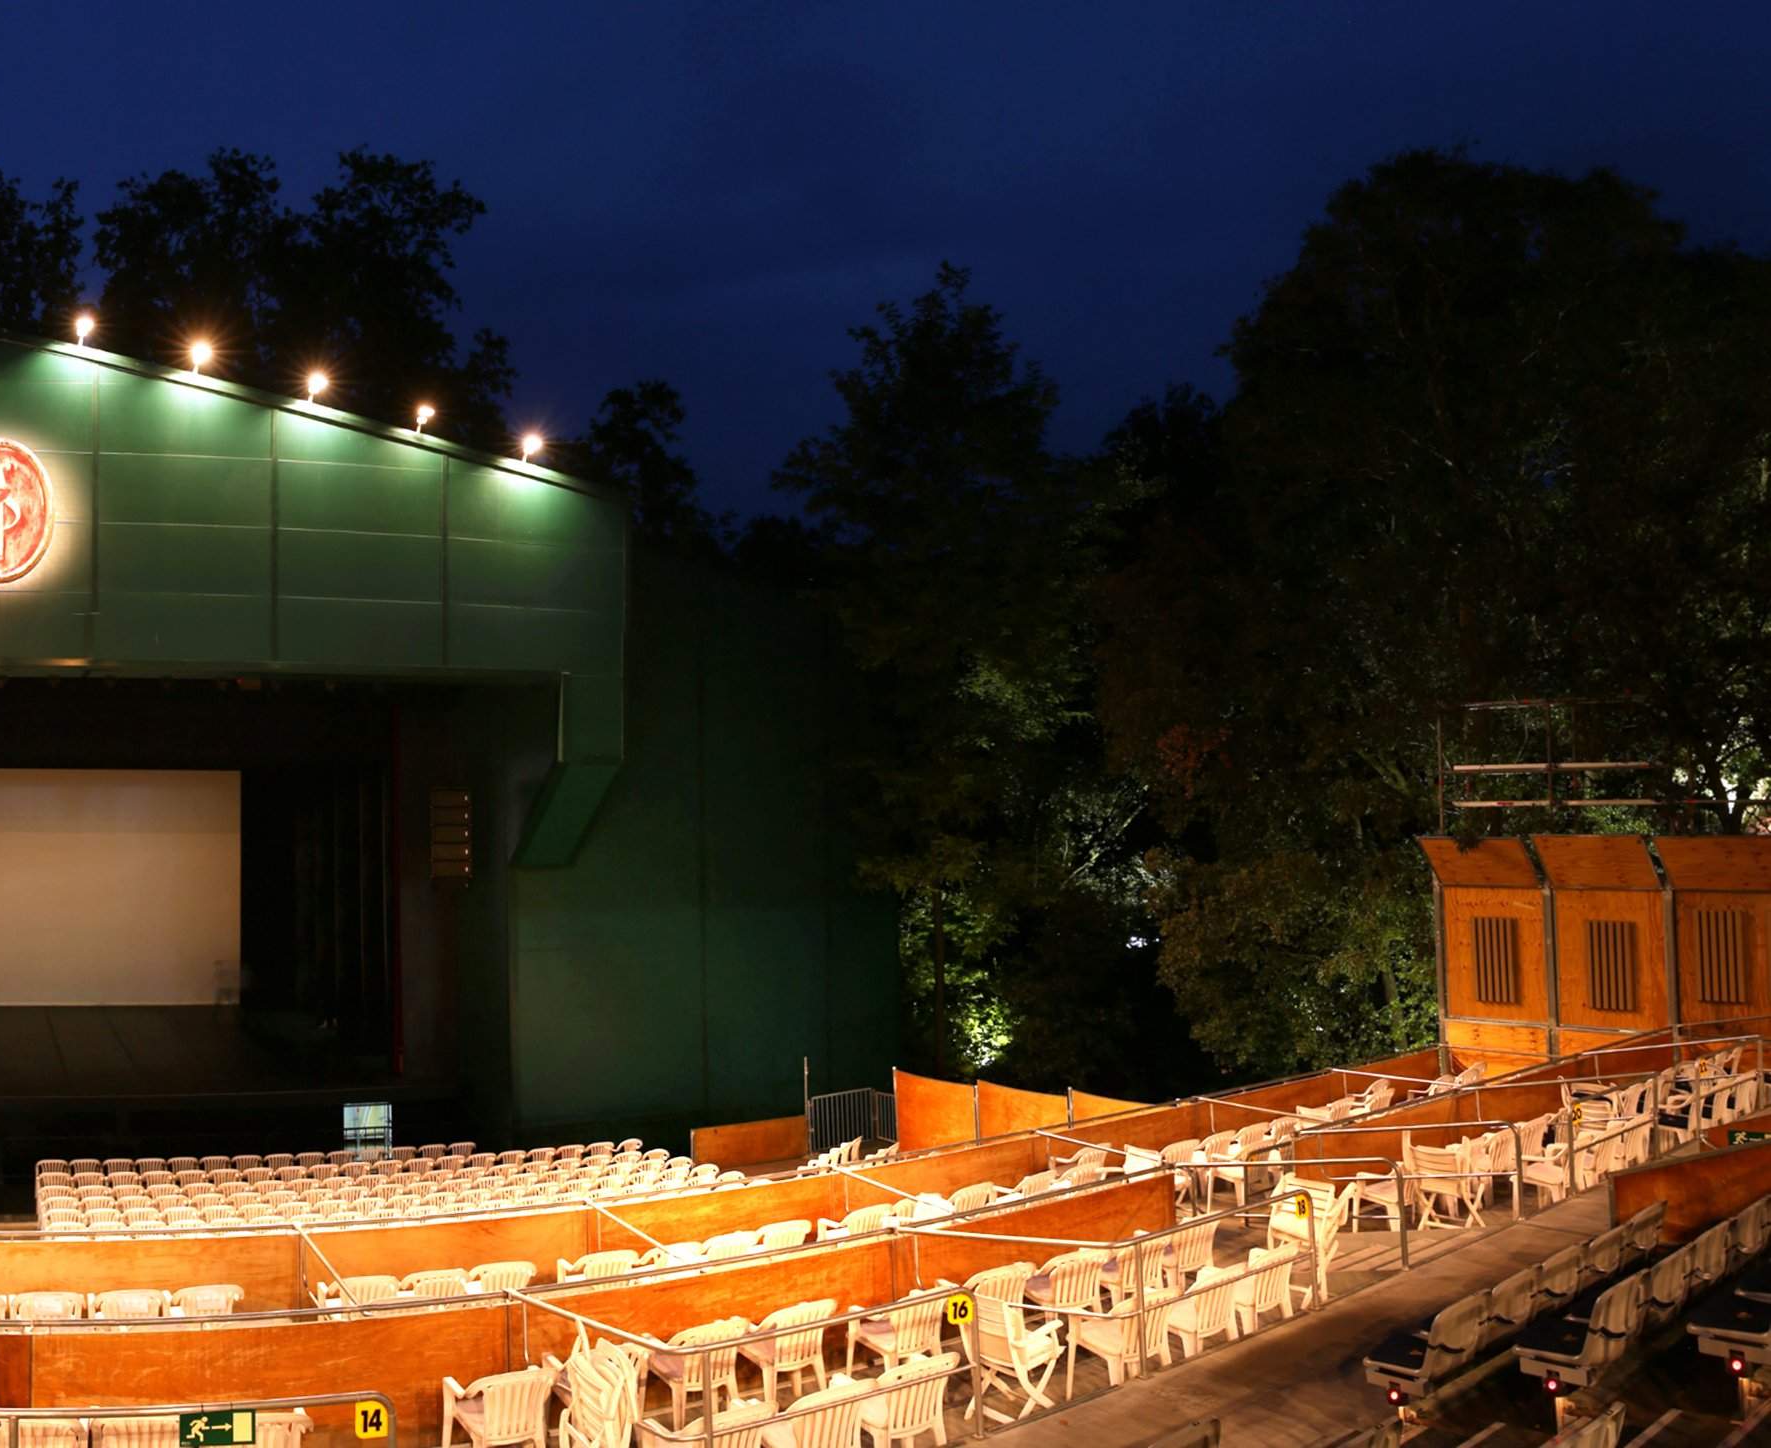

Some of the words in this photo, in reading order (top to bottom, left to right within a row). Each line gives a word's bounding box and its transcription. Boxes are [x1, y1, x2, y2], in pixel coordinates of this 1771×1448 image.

[1298, 1199, 1306, 1215] 18
[952, 1301, 968, 1320] 16
[361, 1408, 382, 1432] 14
